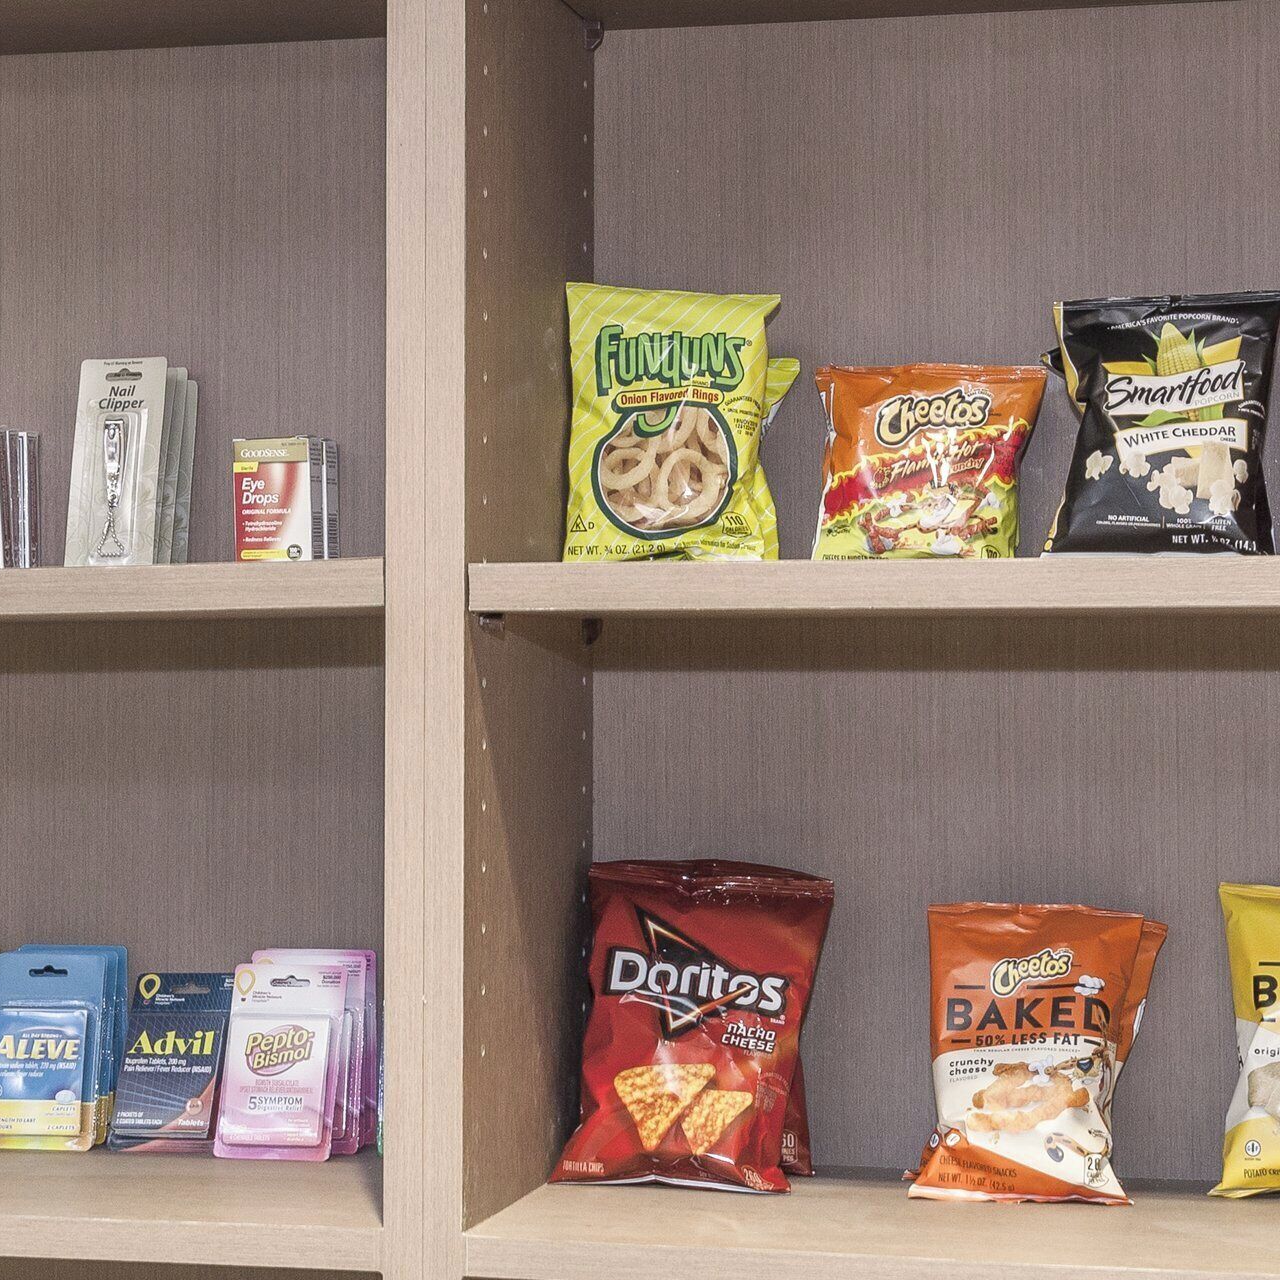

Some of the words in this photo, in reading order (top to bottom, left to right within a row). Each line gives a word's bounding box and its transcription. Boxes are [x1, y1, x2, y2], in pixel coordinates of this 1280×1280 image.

[109, 385, 136, 397] Nail
[1103, 361, 1245, 411] Smartfood
[99, 398, 144, 412] Clipper
[620, 394, 648, 405] Onion
[650, 389, 689, 402] Flavored
[692, 390, 719, 403] Rings
[876, 388, 992, 447] Cheetos
[1124, 431, 1169, 448] WHITE
[1172, 427, 1236, 439] CHEDDAR
[242, 478, 265, 492] Eye
[242, 492, 279, 506] Drops
[610, 950, 786, 1013] Doritos
[992, 949, 1073, 996] Cheetos
[946, 996, 1111, 1032] BAKED
[127, 1030, 214, 1056] Advil
[246, 1027, 314, 1054] Pepto-
[721, 1034, 774, 1053] CHEESE
[975, 1033, 1005, 1046] 50%
[1011, 1033, 1047, 1046] LESS
[1053, 1033, 1081, 1046] FAT
[253, 1042, 312, 1069] Bismol
[949, 1057, 994, 1069] crunchy
[950, 1066, 988, 1076] cheese
[248, 1097, 257, 1111] 5
[258, 1097, 303, 1106] SYMPTOM
